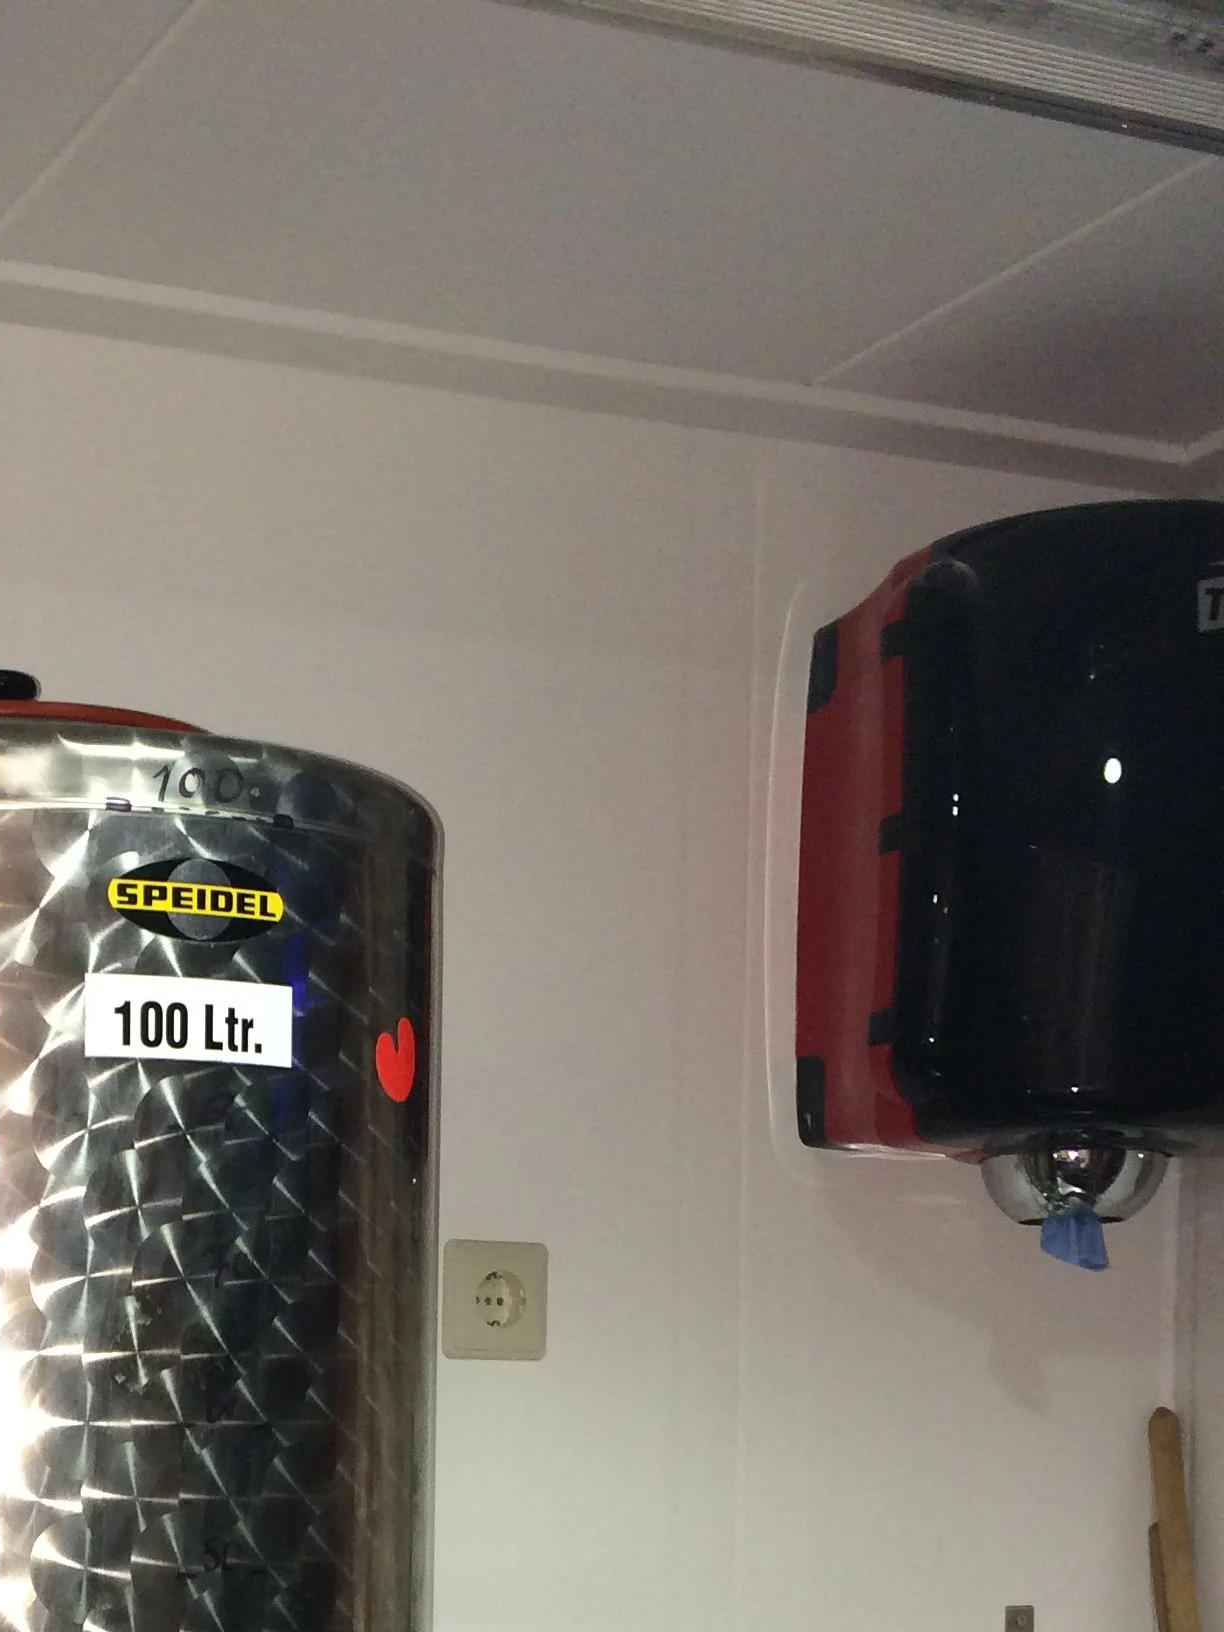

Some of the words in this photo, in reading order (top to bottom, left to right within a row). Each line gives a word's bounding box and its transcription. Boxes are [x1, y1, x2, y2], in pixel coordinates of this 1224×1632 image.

[116, 883, 278, 919] SPEIDEL
[114, 1001, 189, 1050] 100
[203, 1004, 264, 1054] Ltr.
